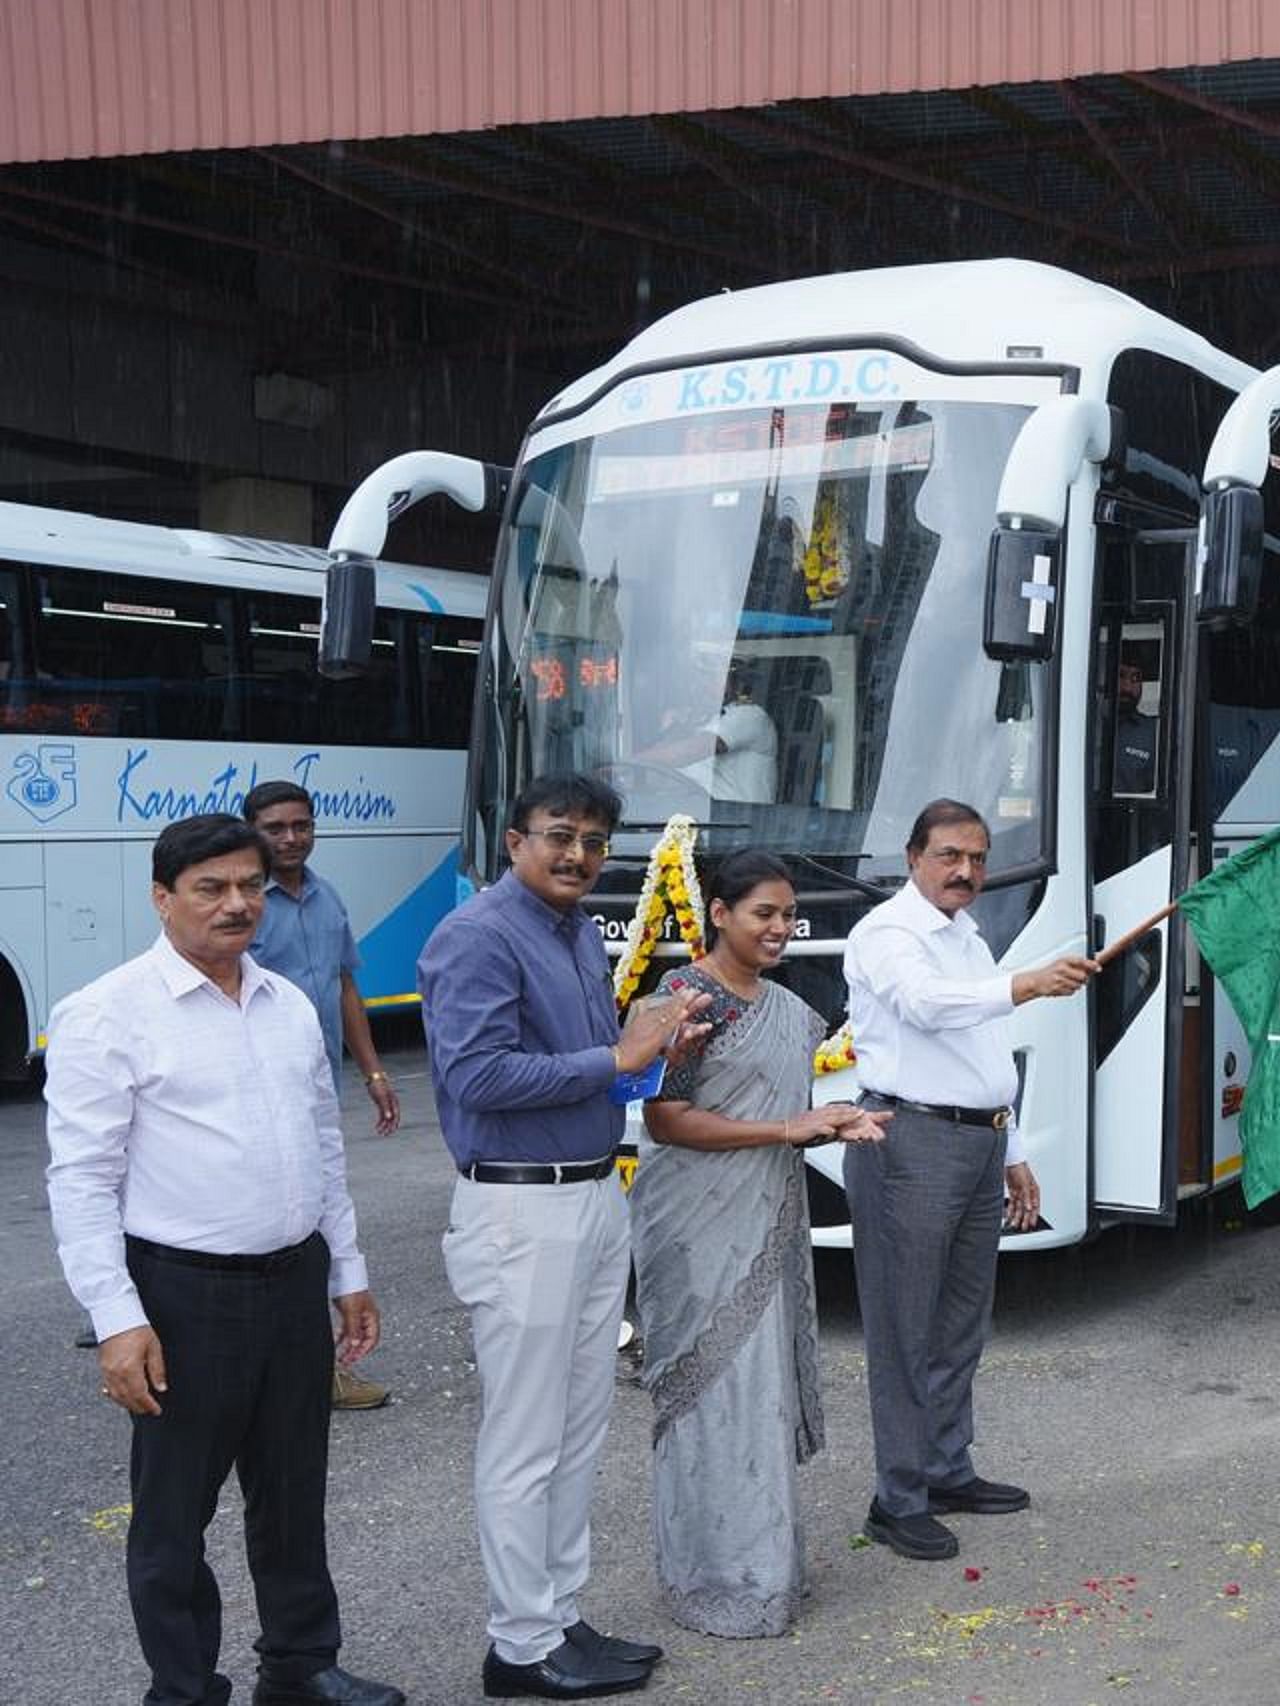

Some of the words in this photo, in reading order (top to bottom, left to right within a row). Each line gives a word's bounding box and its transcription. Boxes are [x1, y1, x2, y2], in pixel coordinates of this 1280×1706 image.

[677, 355, 900, 411] K.S.T.D.C.
[117, 748, 258, 823] Karnata
[293, 752, 397, 822] Tourism
